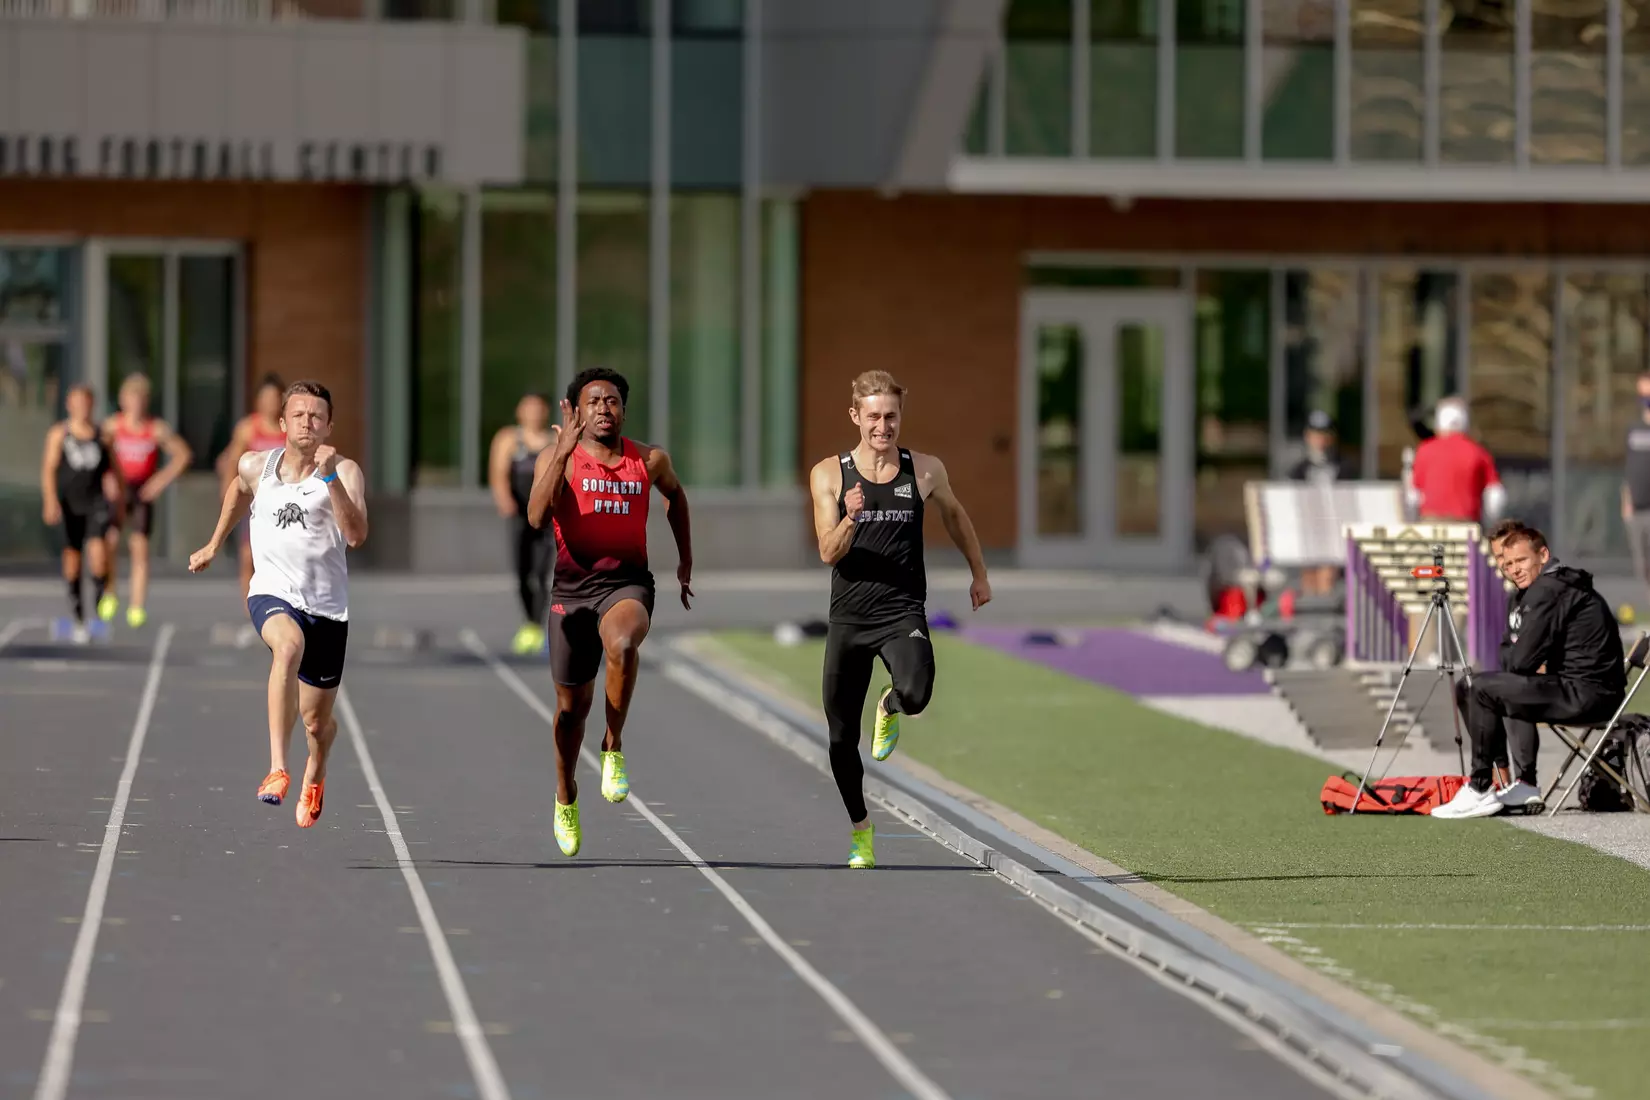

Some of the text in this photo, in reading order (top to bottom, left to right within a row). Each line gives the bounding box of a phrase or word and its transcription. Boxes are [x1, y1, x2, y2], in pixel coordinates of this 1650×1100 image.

[582, 477, 642, 495] SOUTHERN
[594, 499, 630, 515] UTAH
[858, 509, 915, 523] EBER STATE
